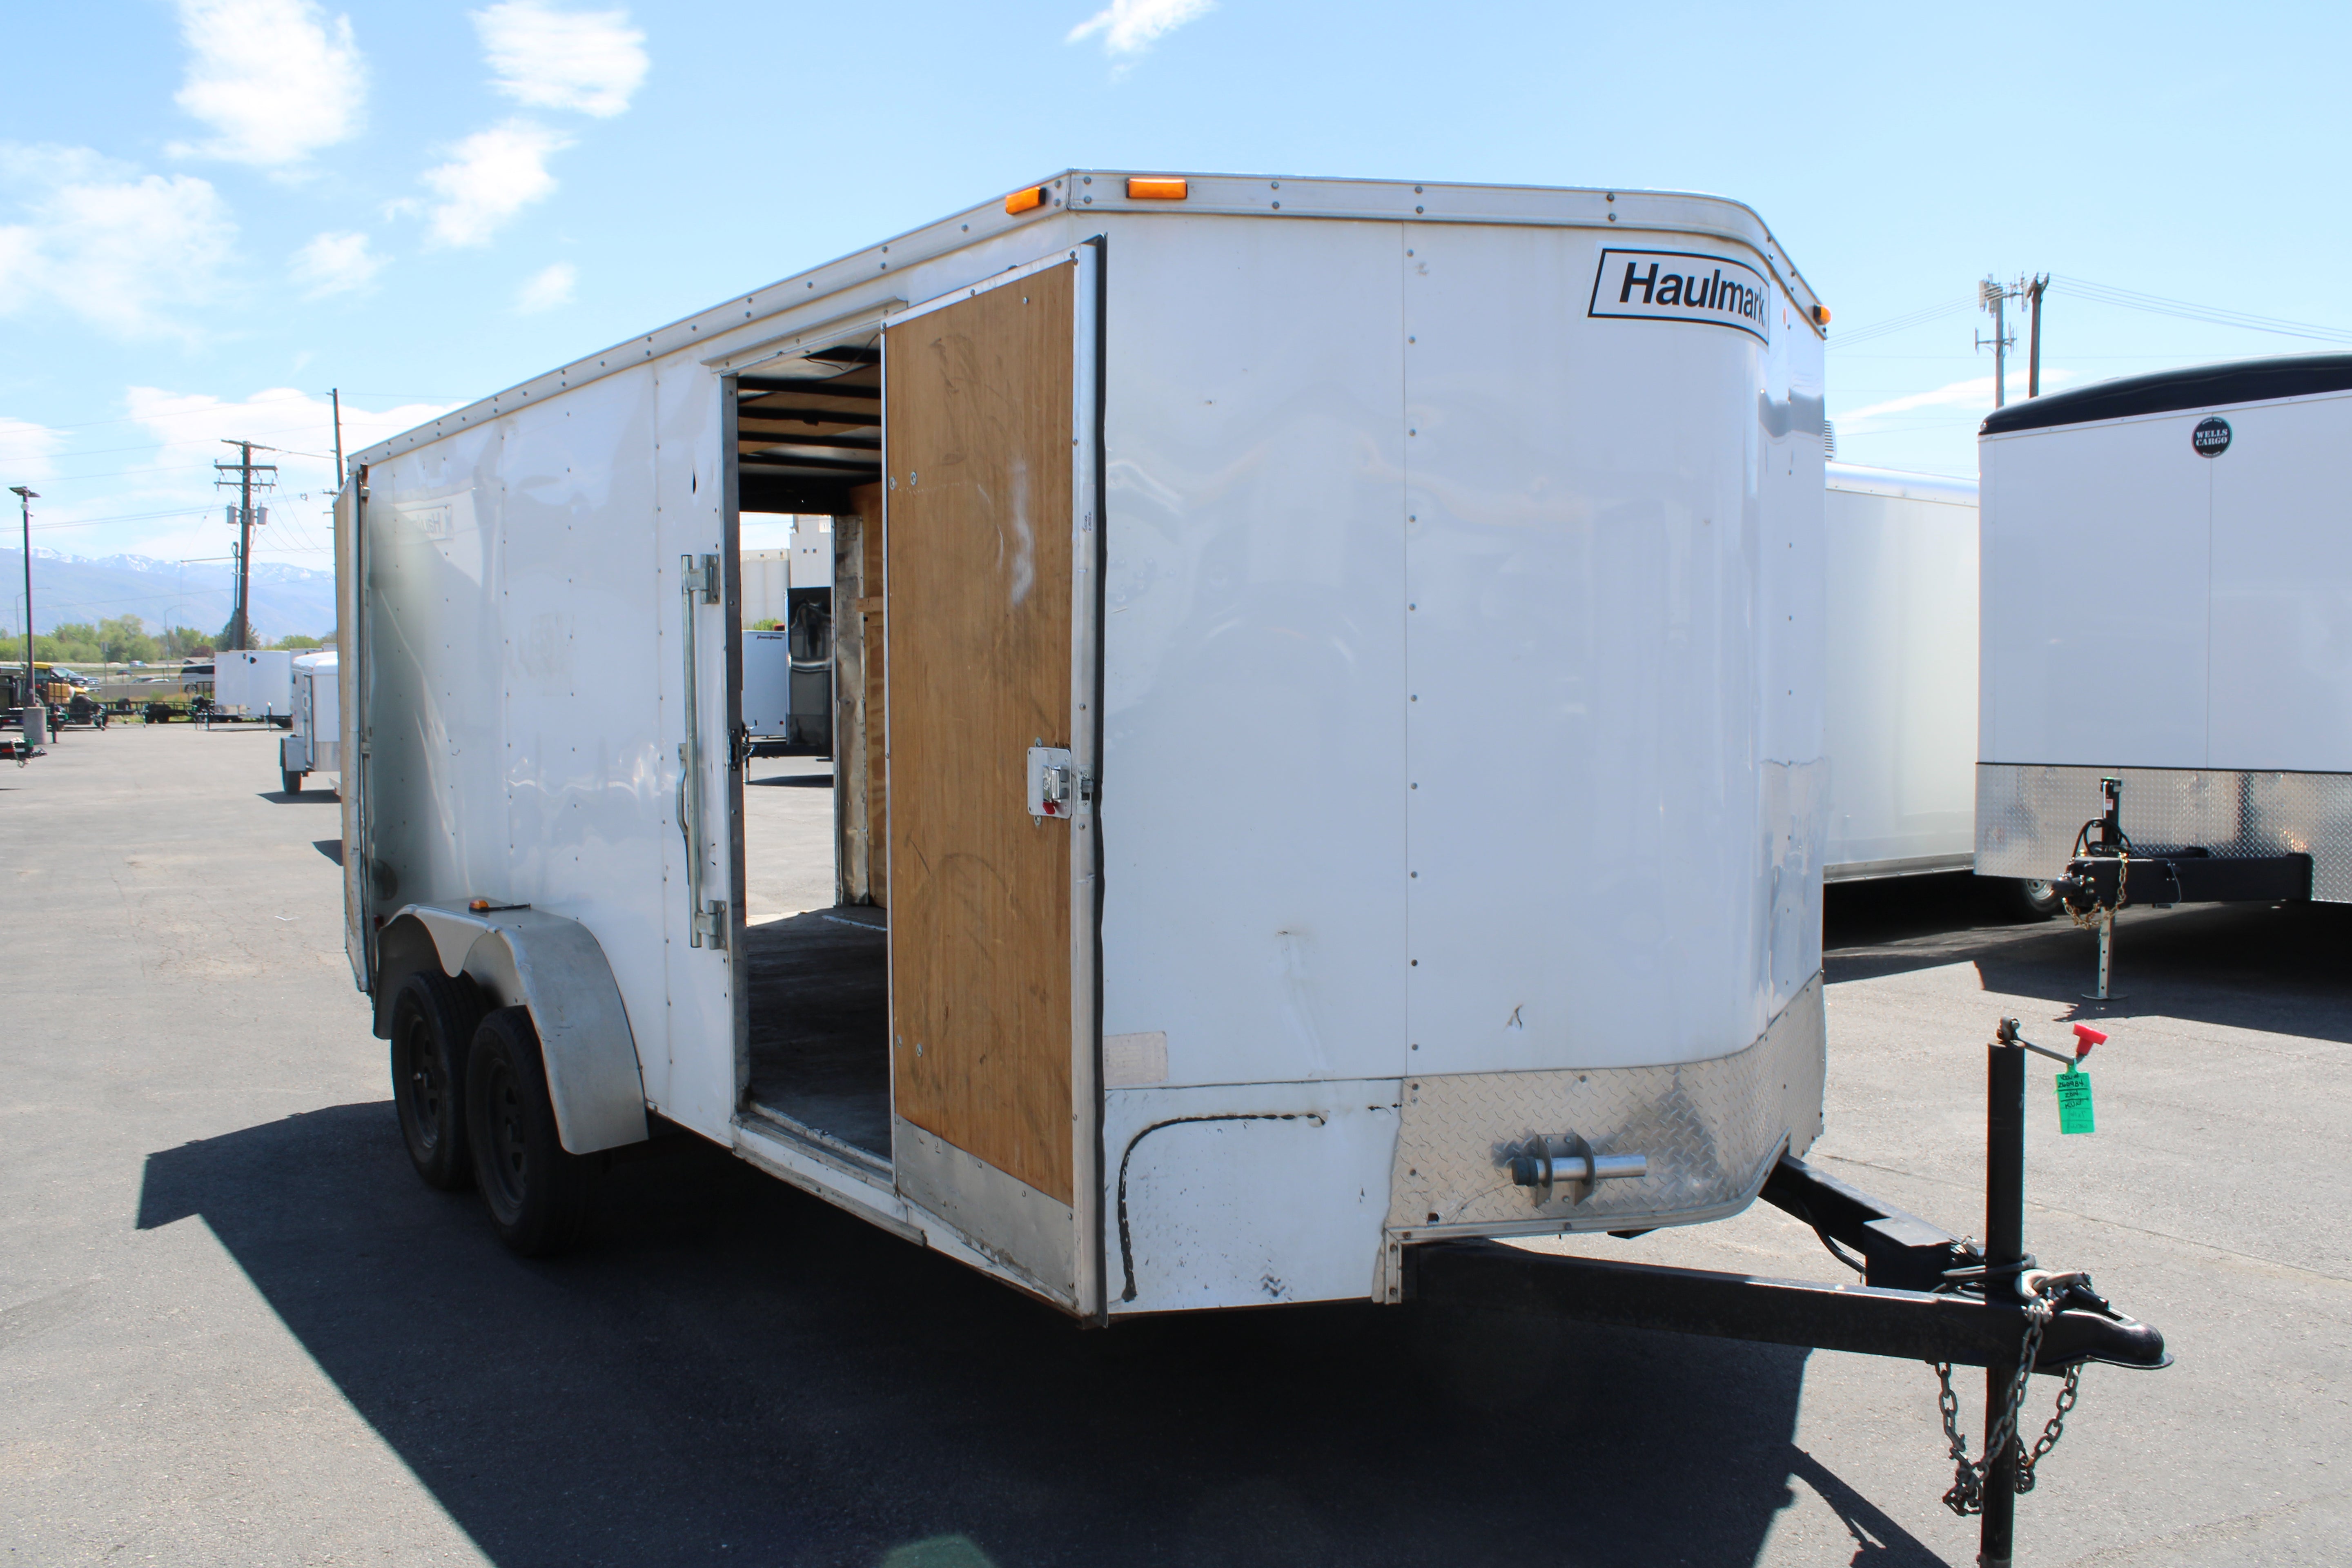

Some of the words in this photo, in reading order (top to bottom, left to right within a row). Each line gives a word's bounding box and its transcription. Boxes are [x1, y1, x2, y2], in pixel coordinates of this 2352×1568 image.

[1619, 262, 1764, 327] Haulmark
[2196, 428, 2228, 439] WELLS
[2195, 436, 2229, 446] CARGO
